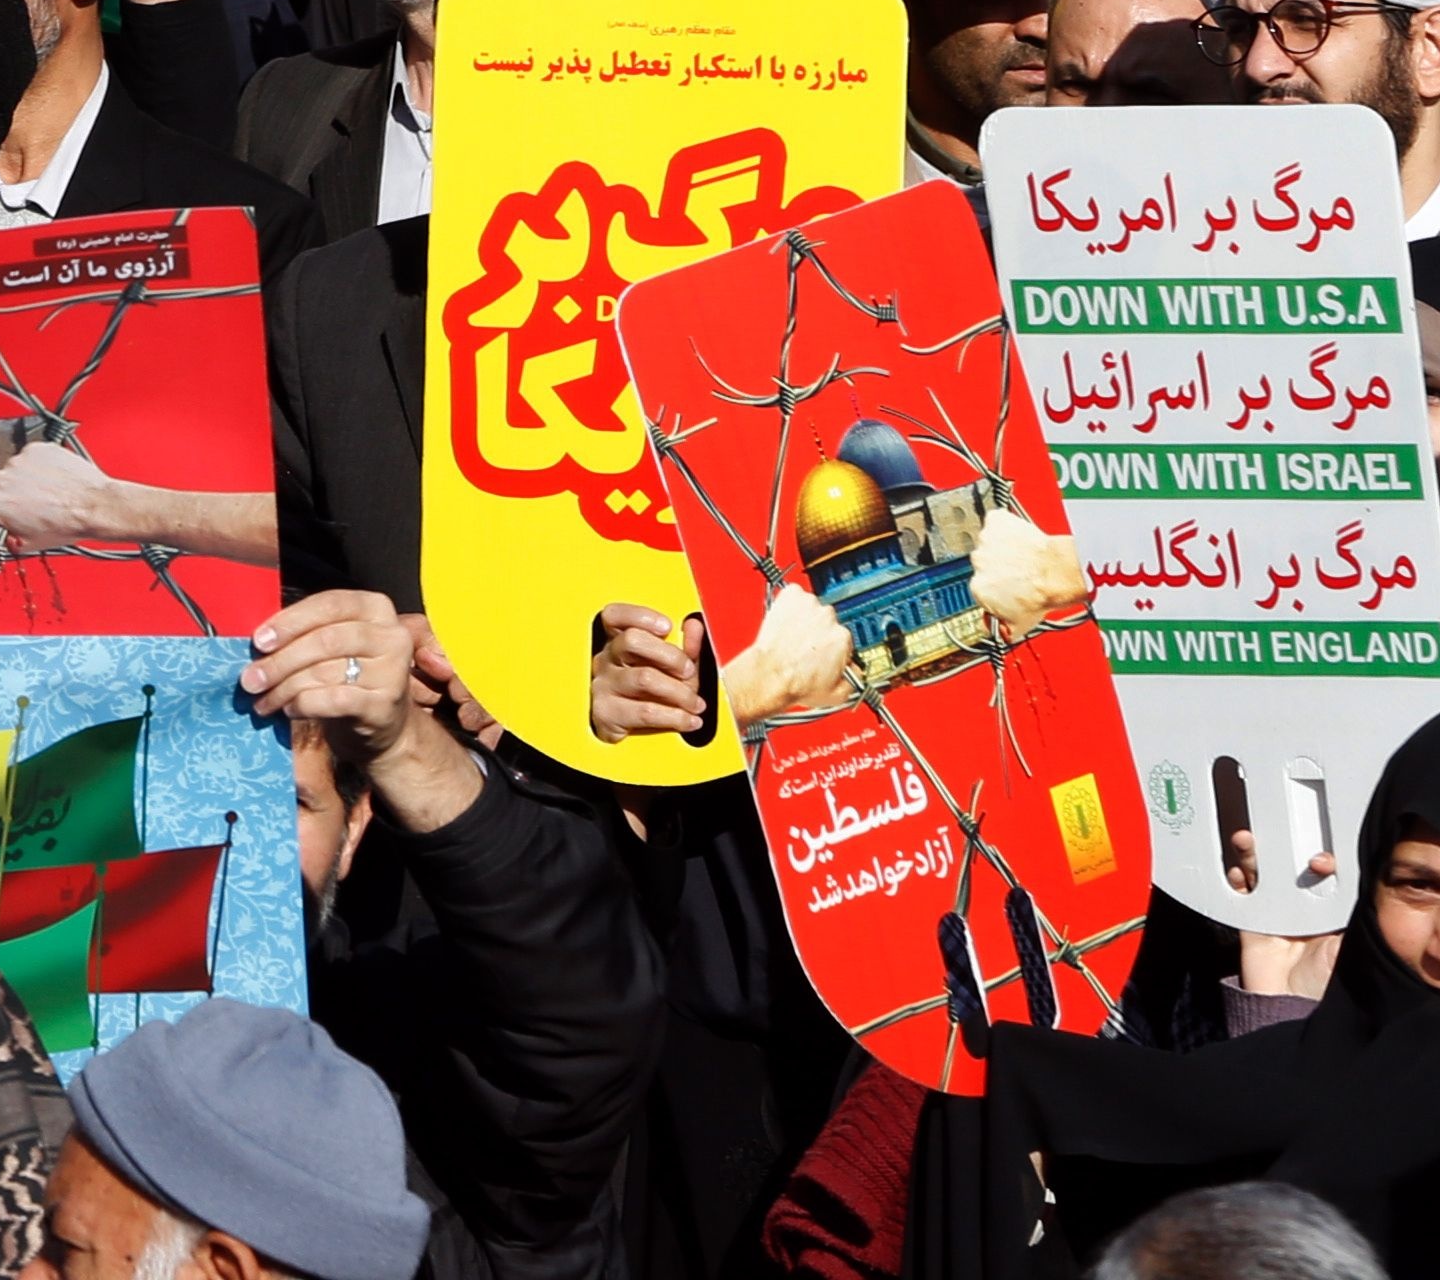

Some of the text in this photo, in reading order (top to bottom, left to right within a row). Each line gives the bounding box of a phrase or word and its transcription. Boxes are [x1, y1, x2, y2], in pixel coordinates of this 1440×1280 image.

[473, 48, 868, 90] مبارزه با استکبار تعطیل پذیر نیست
[3, 267, 49, 285] است
[57, 260, 80, 282] آن
[87, 260, 114, 278] ما
[116, 248, 175, 280] آرزوی
[1170, 454, 1411, 492] WITH ISRAEL
[1254, 520, 1417, 610] مرگ بر
[1173, 632, 1439, 665] WITH ENGLAND
[787, 762, 928, 873] فلسطین
